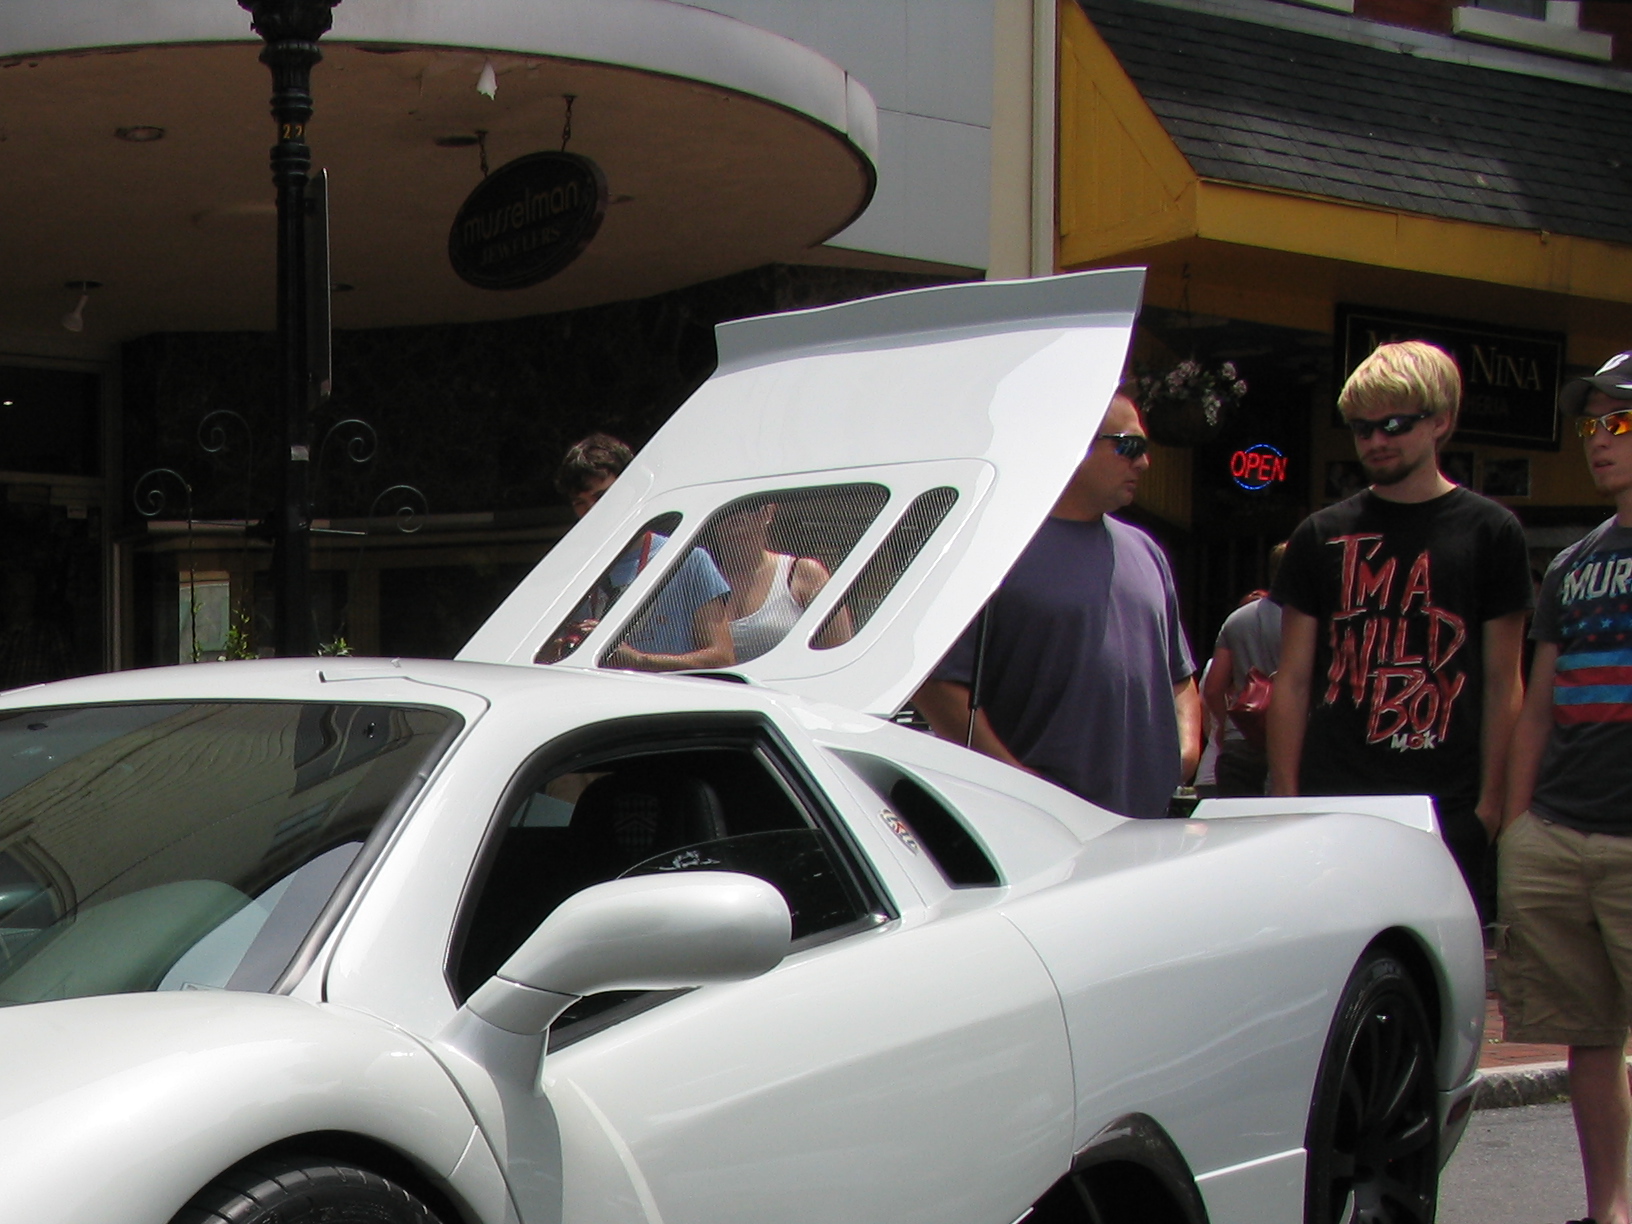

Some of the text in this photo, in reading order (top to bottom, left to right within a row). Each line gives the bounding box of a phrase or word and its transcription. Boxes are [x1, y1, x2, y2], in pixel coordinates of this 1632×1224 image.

[464, 180, 579, 246] musselman
[1470, 343, 1543, 391] NINA
[1230, 450, 1288, 481] OPEN
[1400, 550, 1432, 615] A
[1323, 606, 1466, 708] WILD
[1367, 667, 1466, 744] BOY
